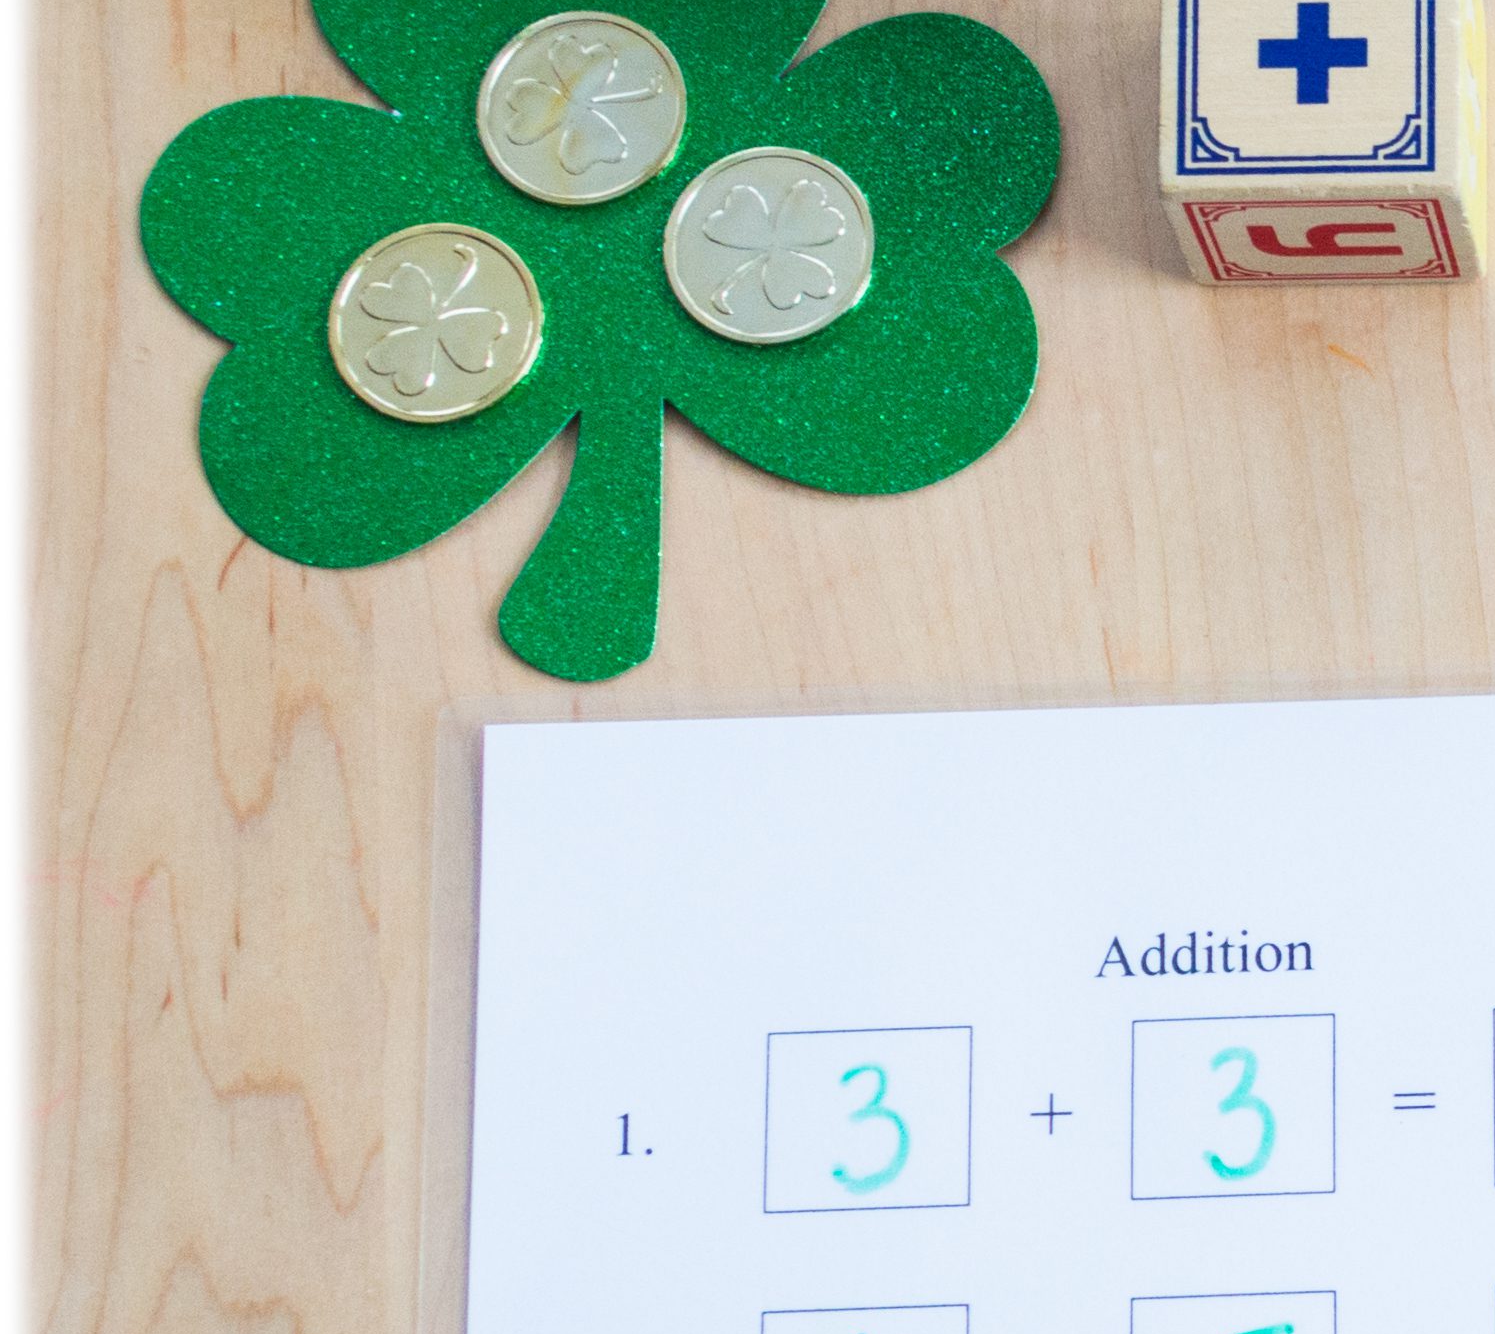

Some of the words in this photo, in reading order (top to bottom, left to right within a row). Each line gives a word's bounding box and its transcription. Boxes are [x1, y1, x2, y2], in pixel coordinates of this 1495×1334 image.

[1095, 928, 1315, 980] Addition
[620, 1113, 653, 1156] 1.
[830, 1062, 912, 1195] 3
[1031, 1094, 1072, 1134] +
[1202, 1047, 1277, 1182] 3
[1394, 1092, 1435, 1110] =
